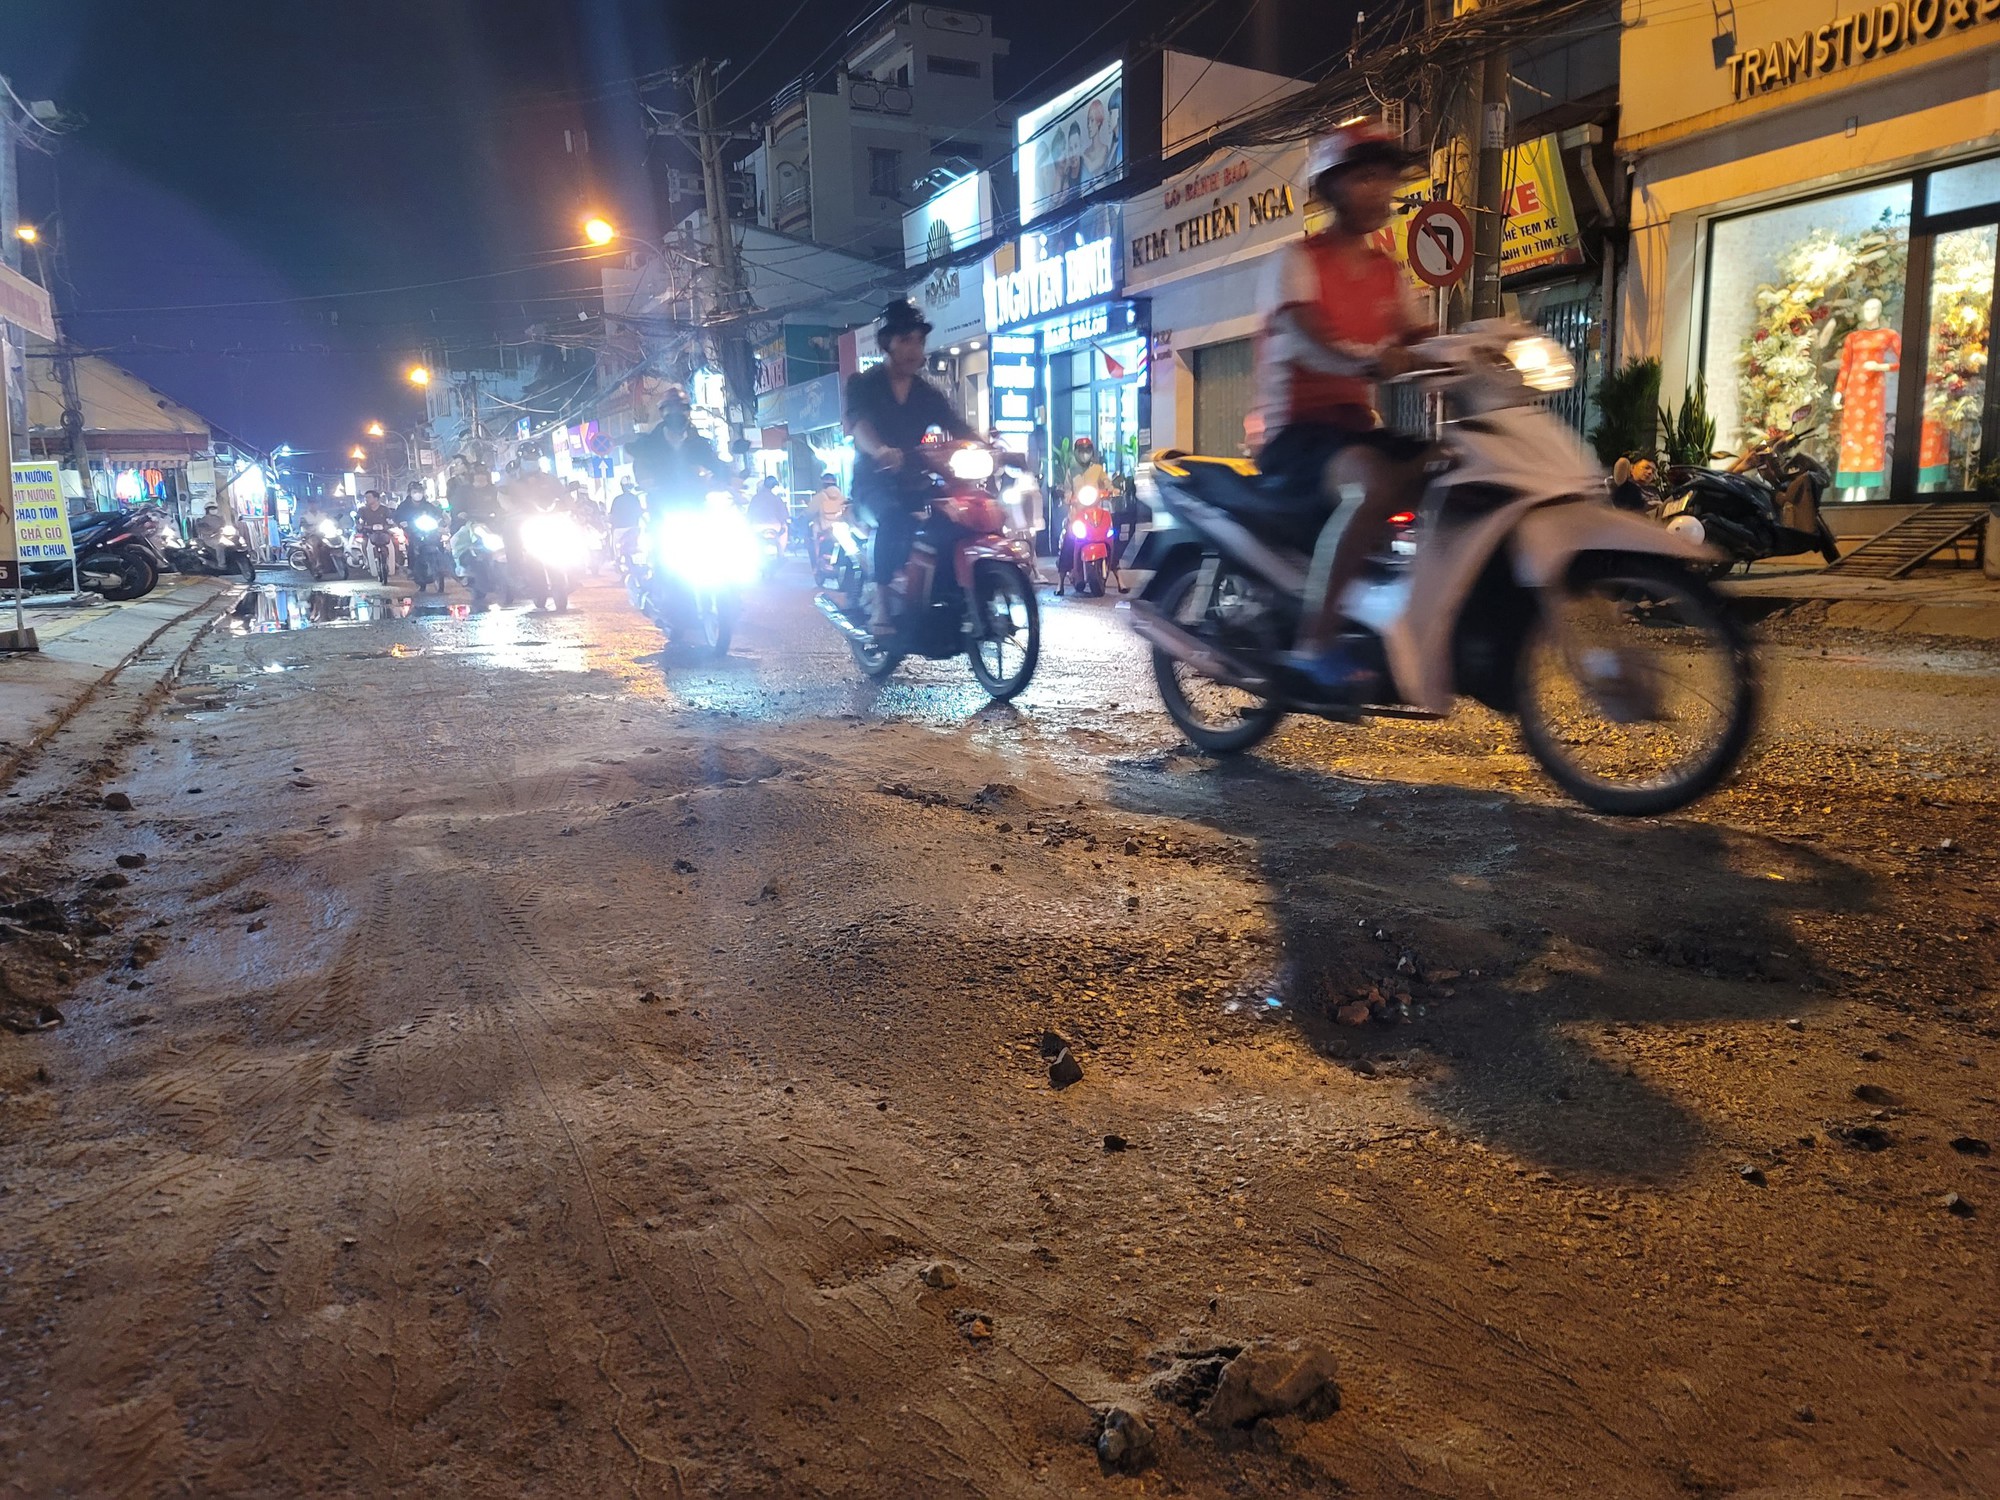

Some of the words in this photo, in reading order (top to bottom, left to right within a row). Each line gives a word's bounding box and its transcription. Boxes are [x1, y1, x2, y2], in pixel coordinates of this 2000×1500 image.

[1131, 228, 1170, 268] KIM
[1248, 184, 1295, 228] NGA
[1545, 216, 1559, 231] XE
[1557, 233, 1570, 247] XE
[20, 545, 40, 557] NEM
[43, 543, 66, 556] CHUA
